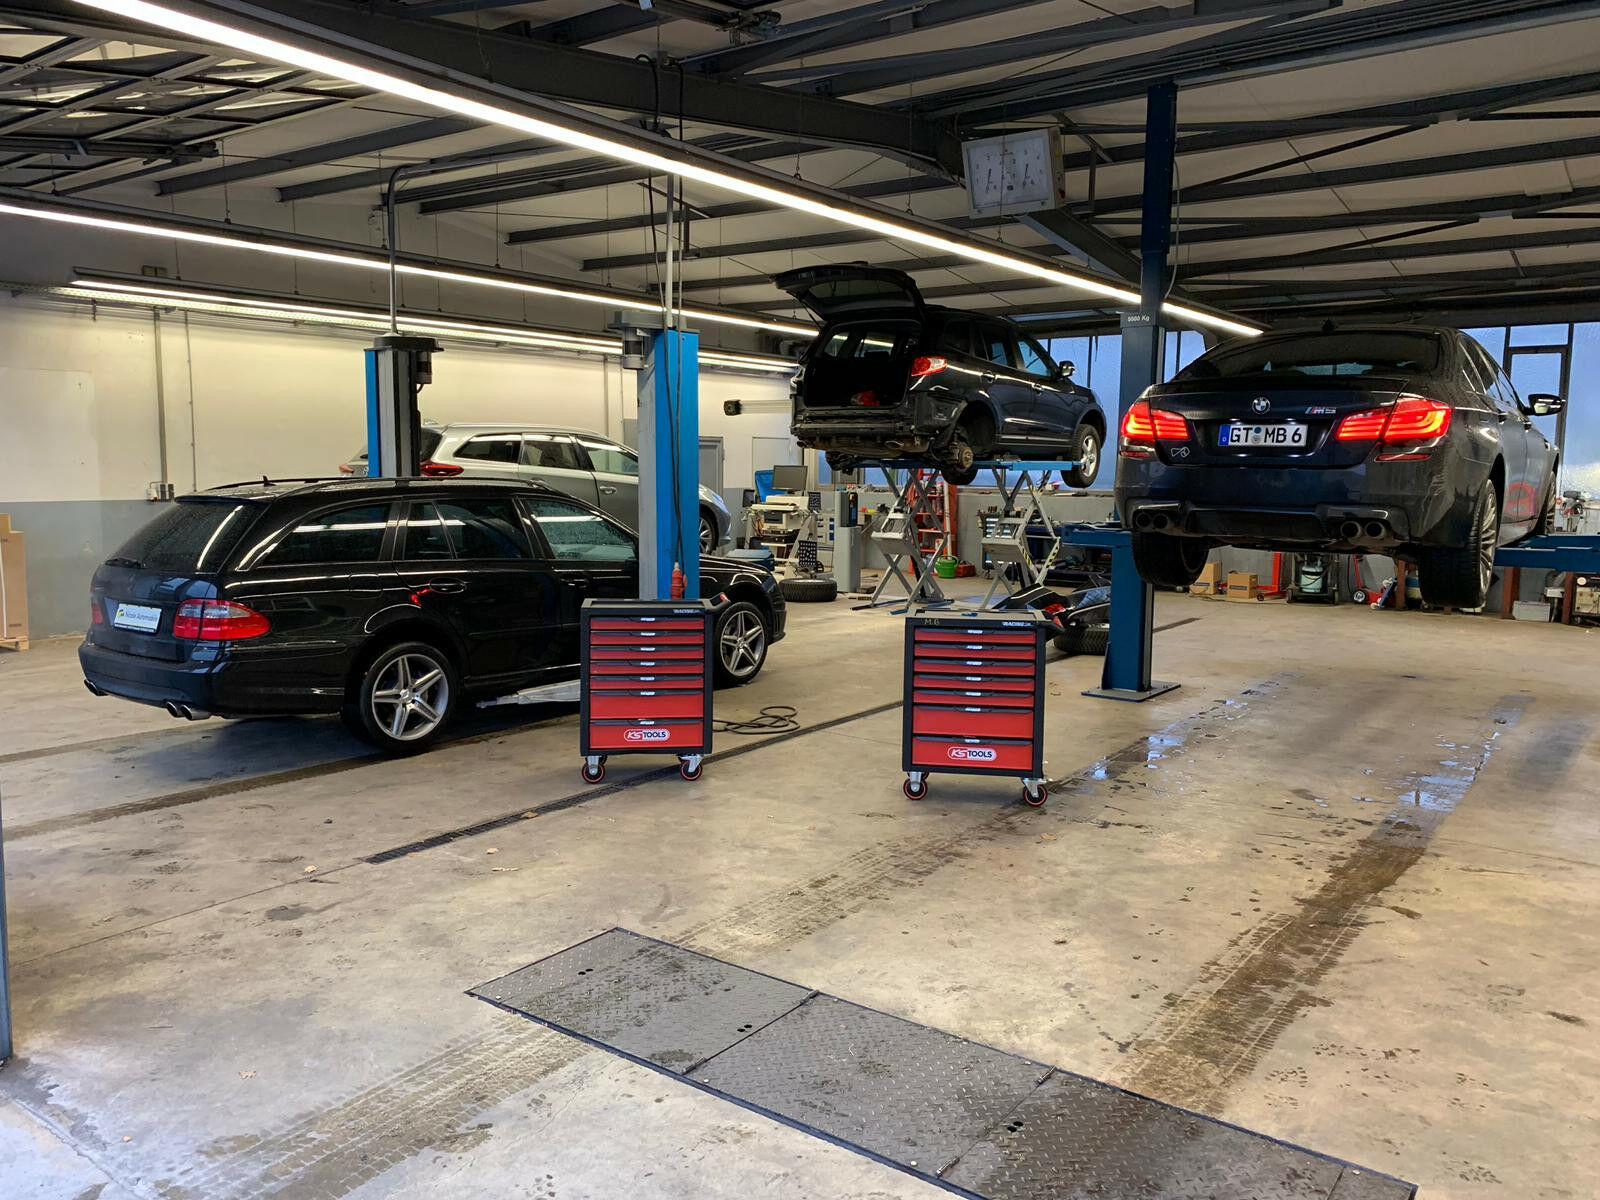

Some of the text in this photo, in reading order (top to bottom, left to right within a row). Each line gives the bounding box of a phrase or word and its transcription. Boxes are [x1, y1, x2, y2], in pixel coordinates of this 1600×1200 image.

[1230, 427, 1253, 443] GT
[1263, 427, 1287, 443] MB
[1291, 427, 1302, 443] 6
[627, 731, 642, 739] KS
[951, 749, 993, 758] KS TOOLS
